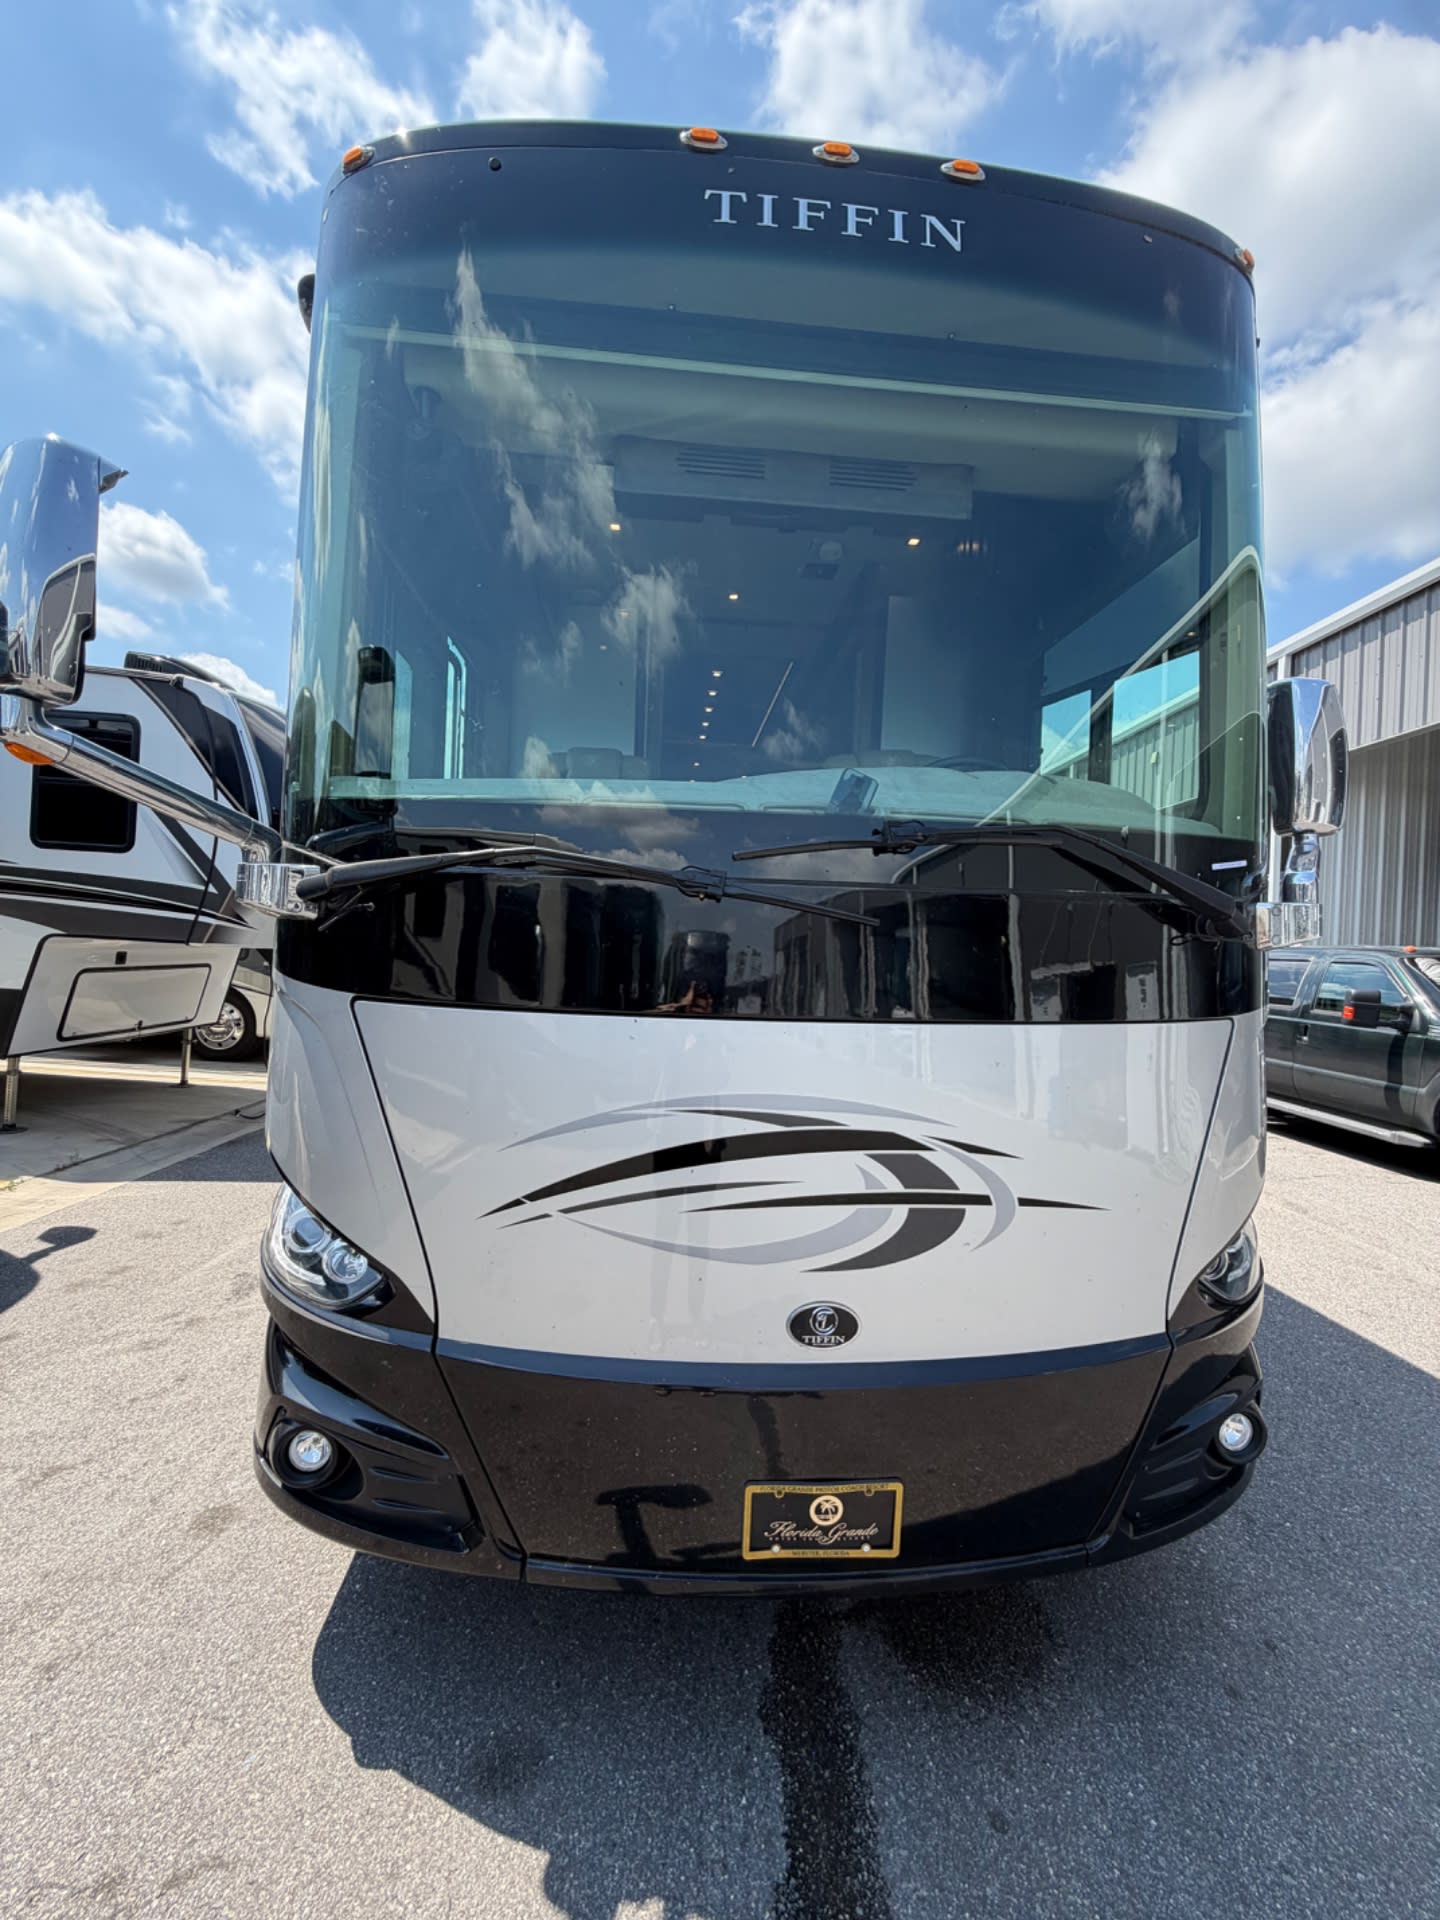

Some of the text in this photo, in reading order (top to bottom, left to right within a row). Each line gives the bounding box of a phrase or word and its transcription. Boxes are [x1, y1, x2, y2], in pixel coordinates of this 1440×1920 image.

[704, 189, 966, 252] TIFFIN
[801, 1335, 846, 1344] TIFFIN
[763, 1521, 879, 1545] Florida Grande
